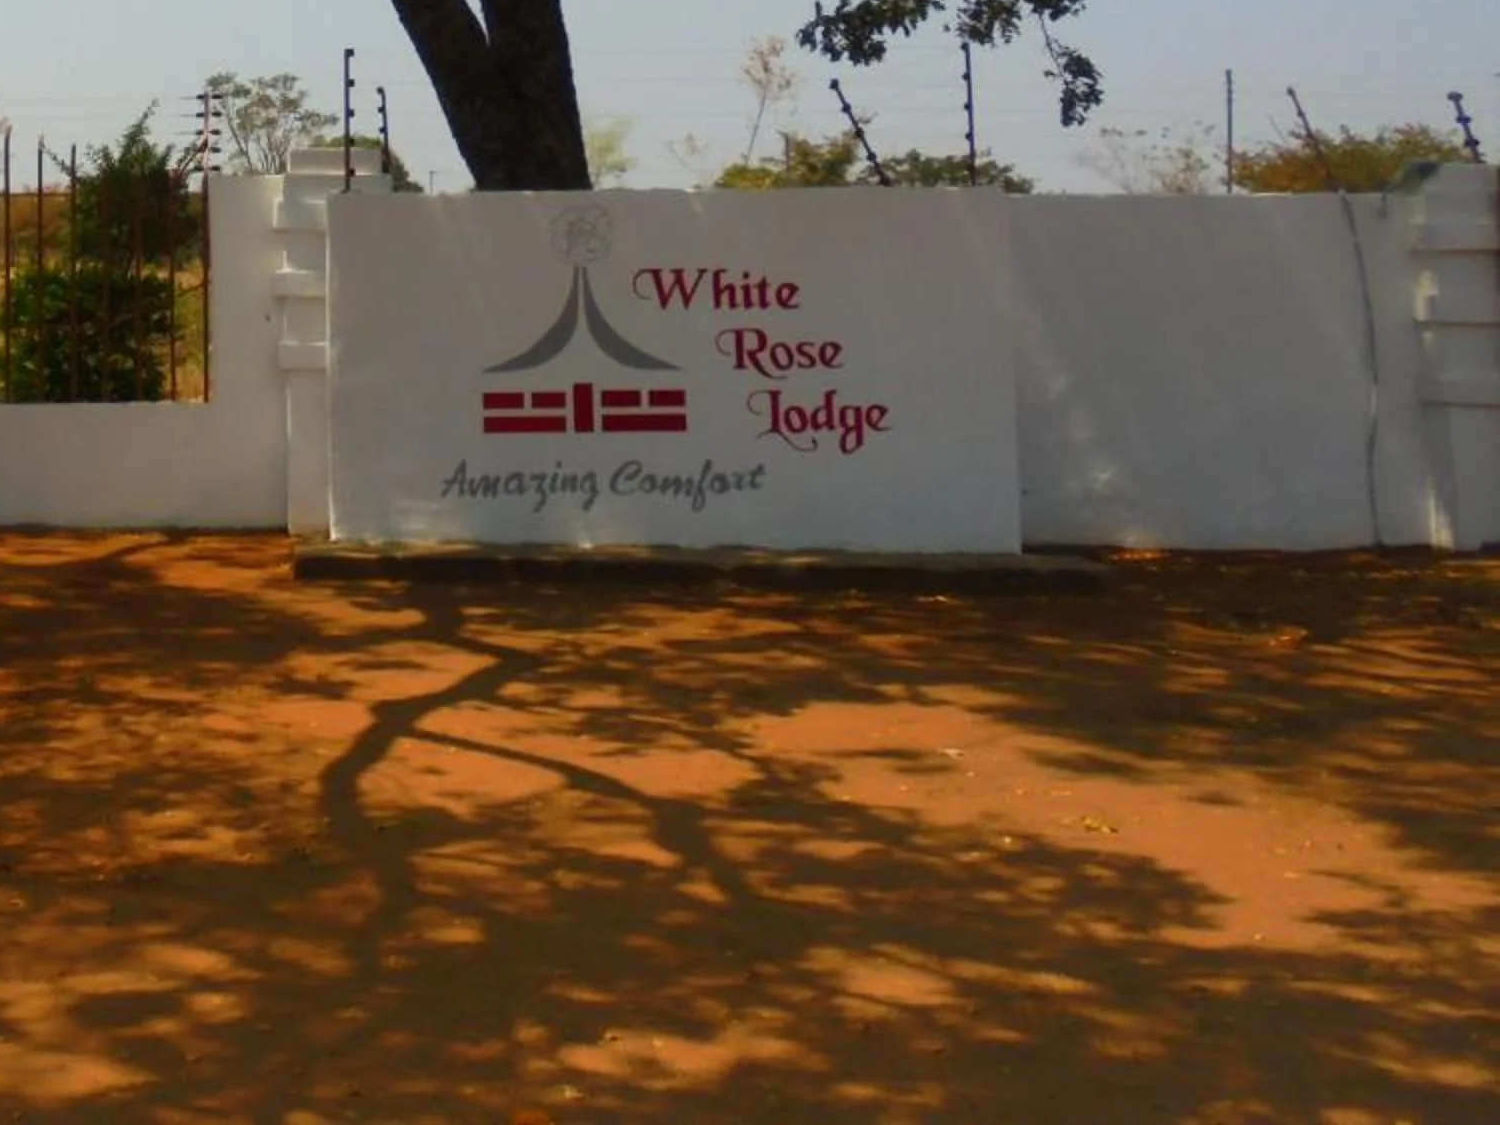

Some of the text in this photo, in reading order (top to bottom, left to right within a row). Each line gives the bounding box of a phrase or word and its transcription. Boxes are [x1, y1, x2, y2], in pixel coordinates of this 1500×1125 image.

[632, 267, 800, 310] White
[715, 327, 843, 379] Rose
[746, 388, 891, 455] Lodge
[441, 458, 766, 512] Amazing Comfort
